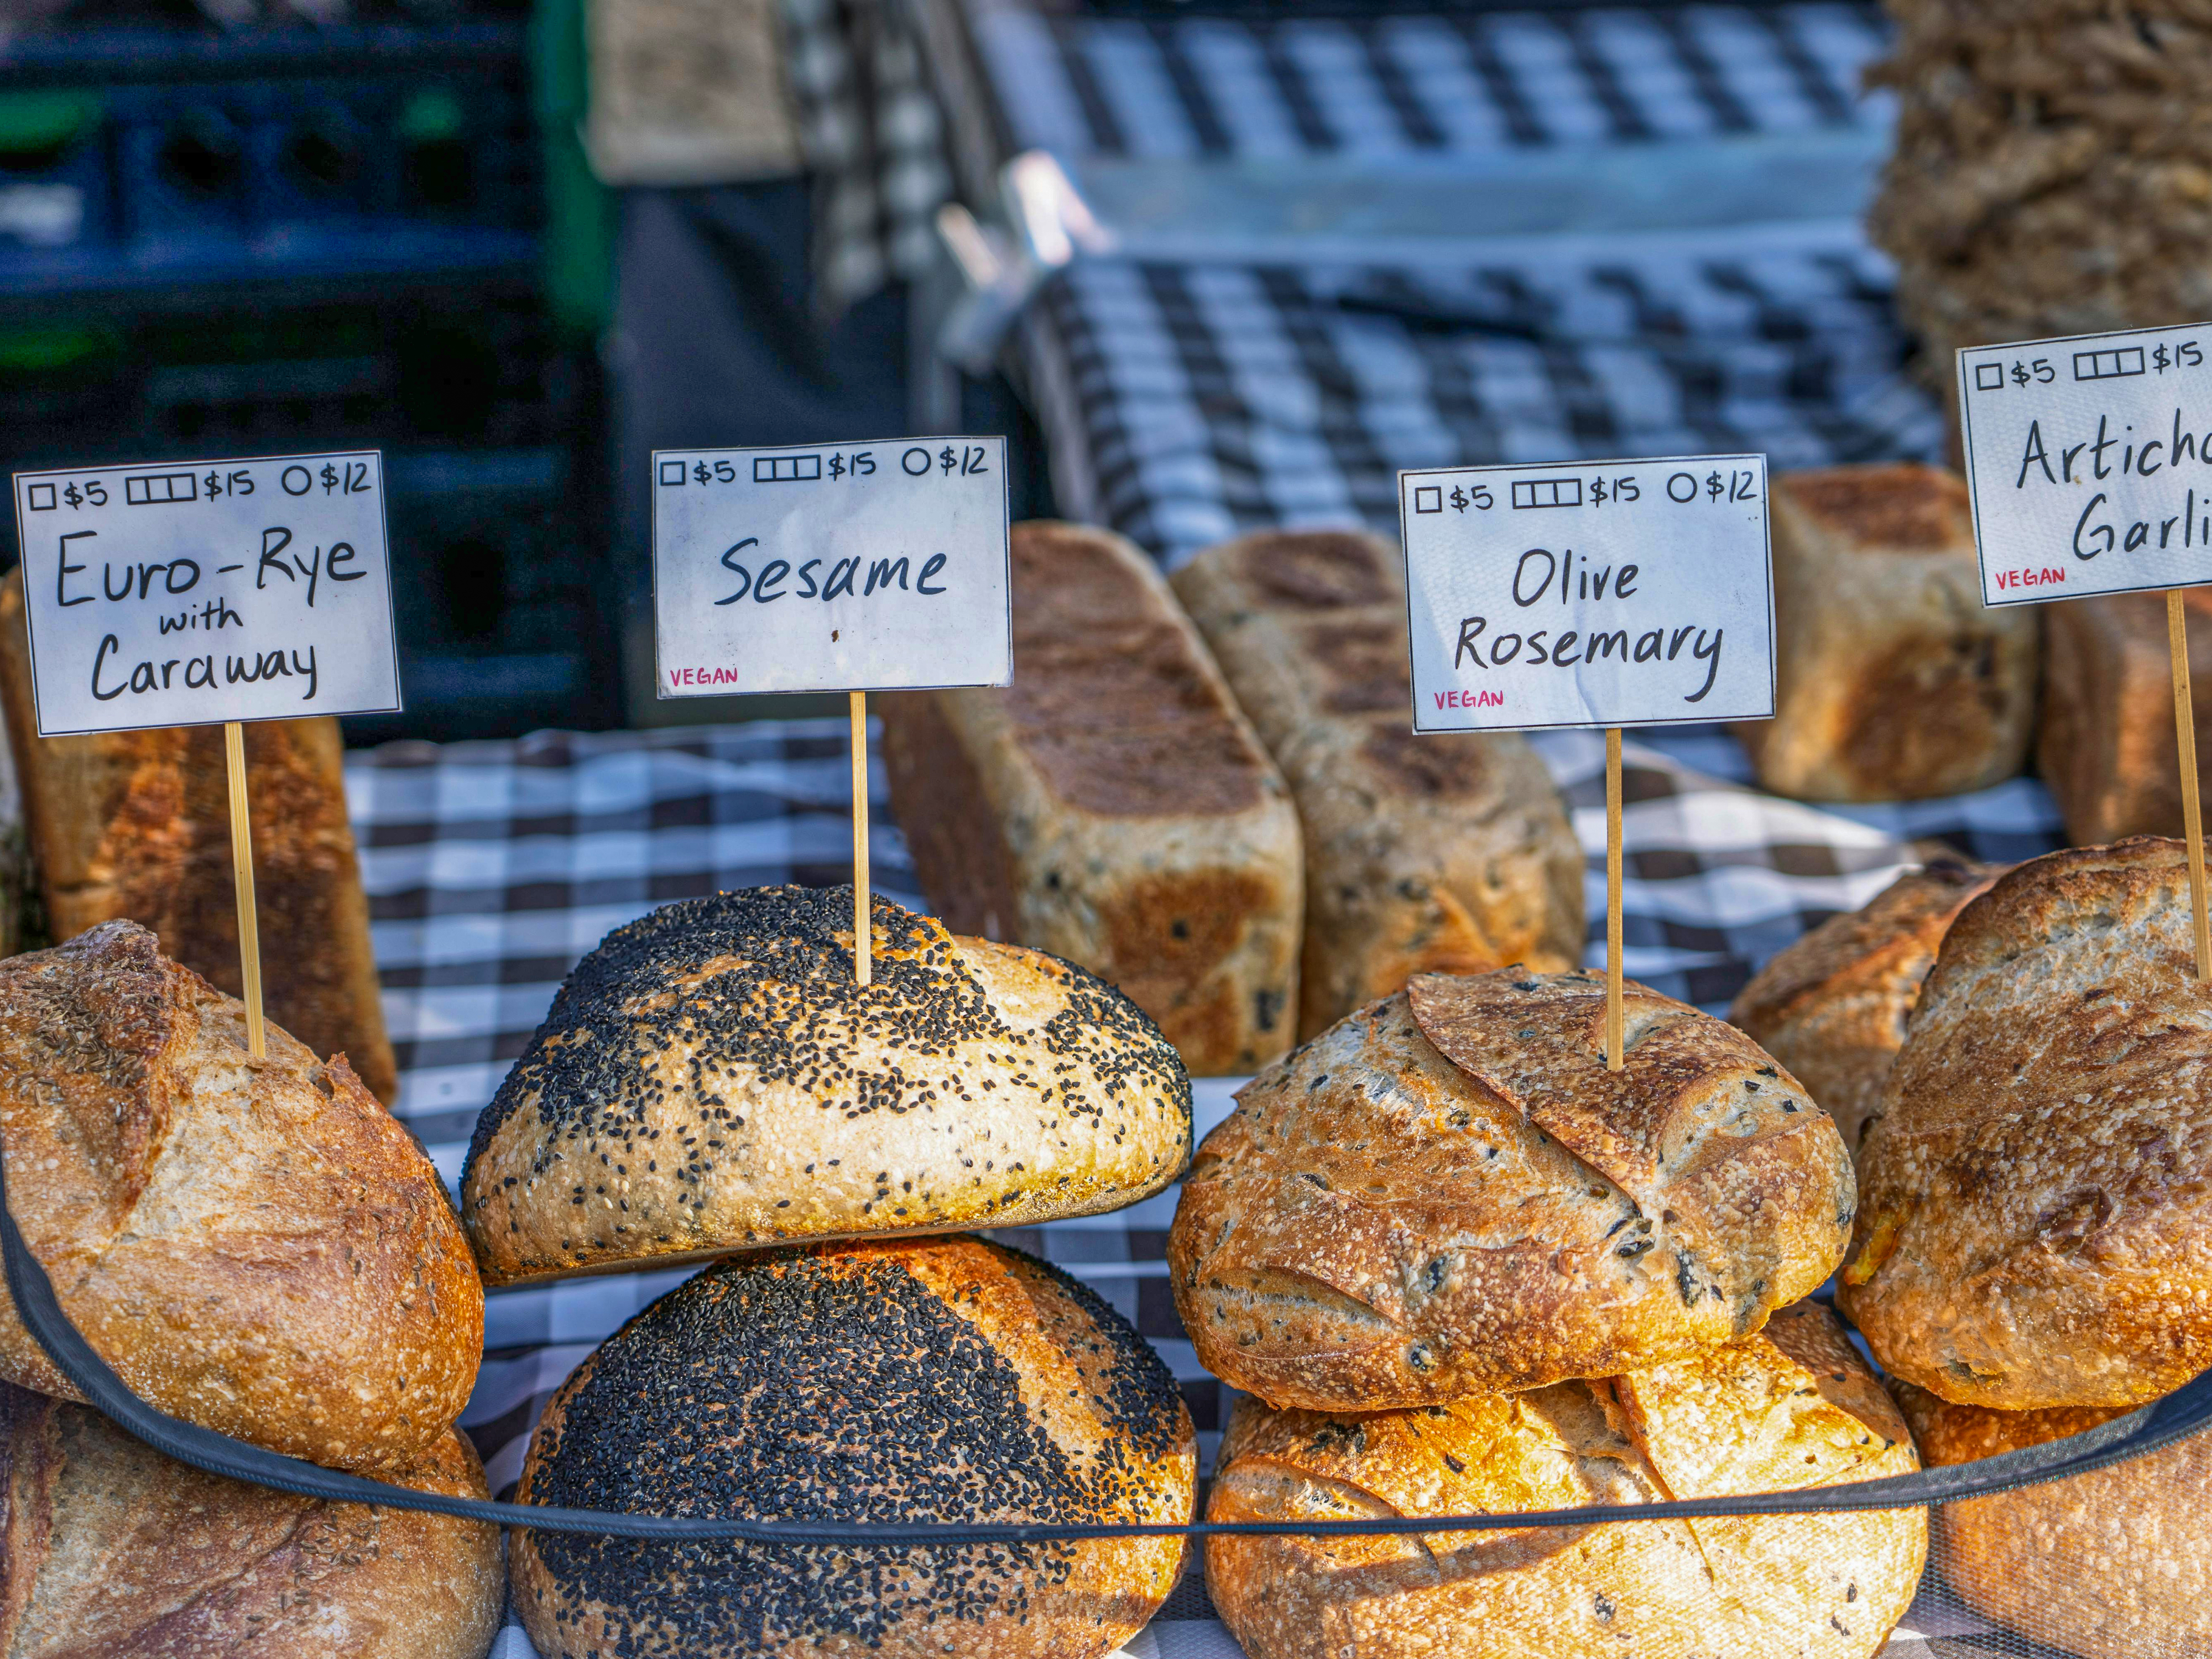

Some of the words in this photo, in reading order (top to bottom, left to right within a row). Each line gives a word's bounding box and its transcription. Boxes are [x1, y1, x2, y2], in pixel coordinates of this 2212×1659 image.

[2011, 359, 2055, 388] $5
[2153, 341, 2203, 374] $15
[64, 481, 108, 510] $5
[204, 470, 255, 502] $15
[320, 462, 372, 495] $12
[694, 461, 735, 486] $5
[828, 452, 876, 481] $15
[940, 446, 988, 476] $12
[1450, 486, 1493, 513] $5
[1590, 477, 1640, 508] $15
[1707, 471, 1757, 503] $12
[714, 538, 946, 605] Sesame
[1513, 549, 1638, 607] Olive
[1995, 567, 2065, 590] VEGAN
[160, 597, 243, 635] with
[92, 634, 317, 701] Caraway
[670, 667, 738, 687] VEGAN
[1455, 617, 1723, 702] Rosemary
[1435, 690, 1504, 709] VEGAN
